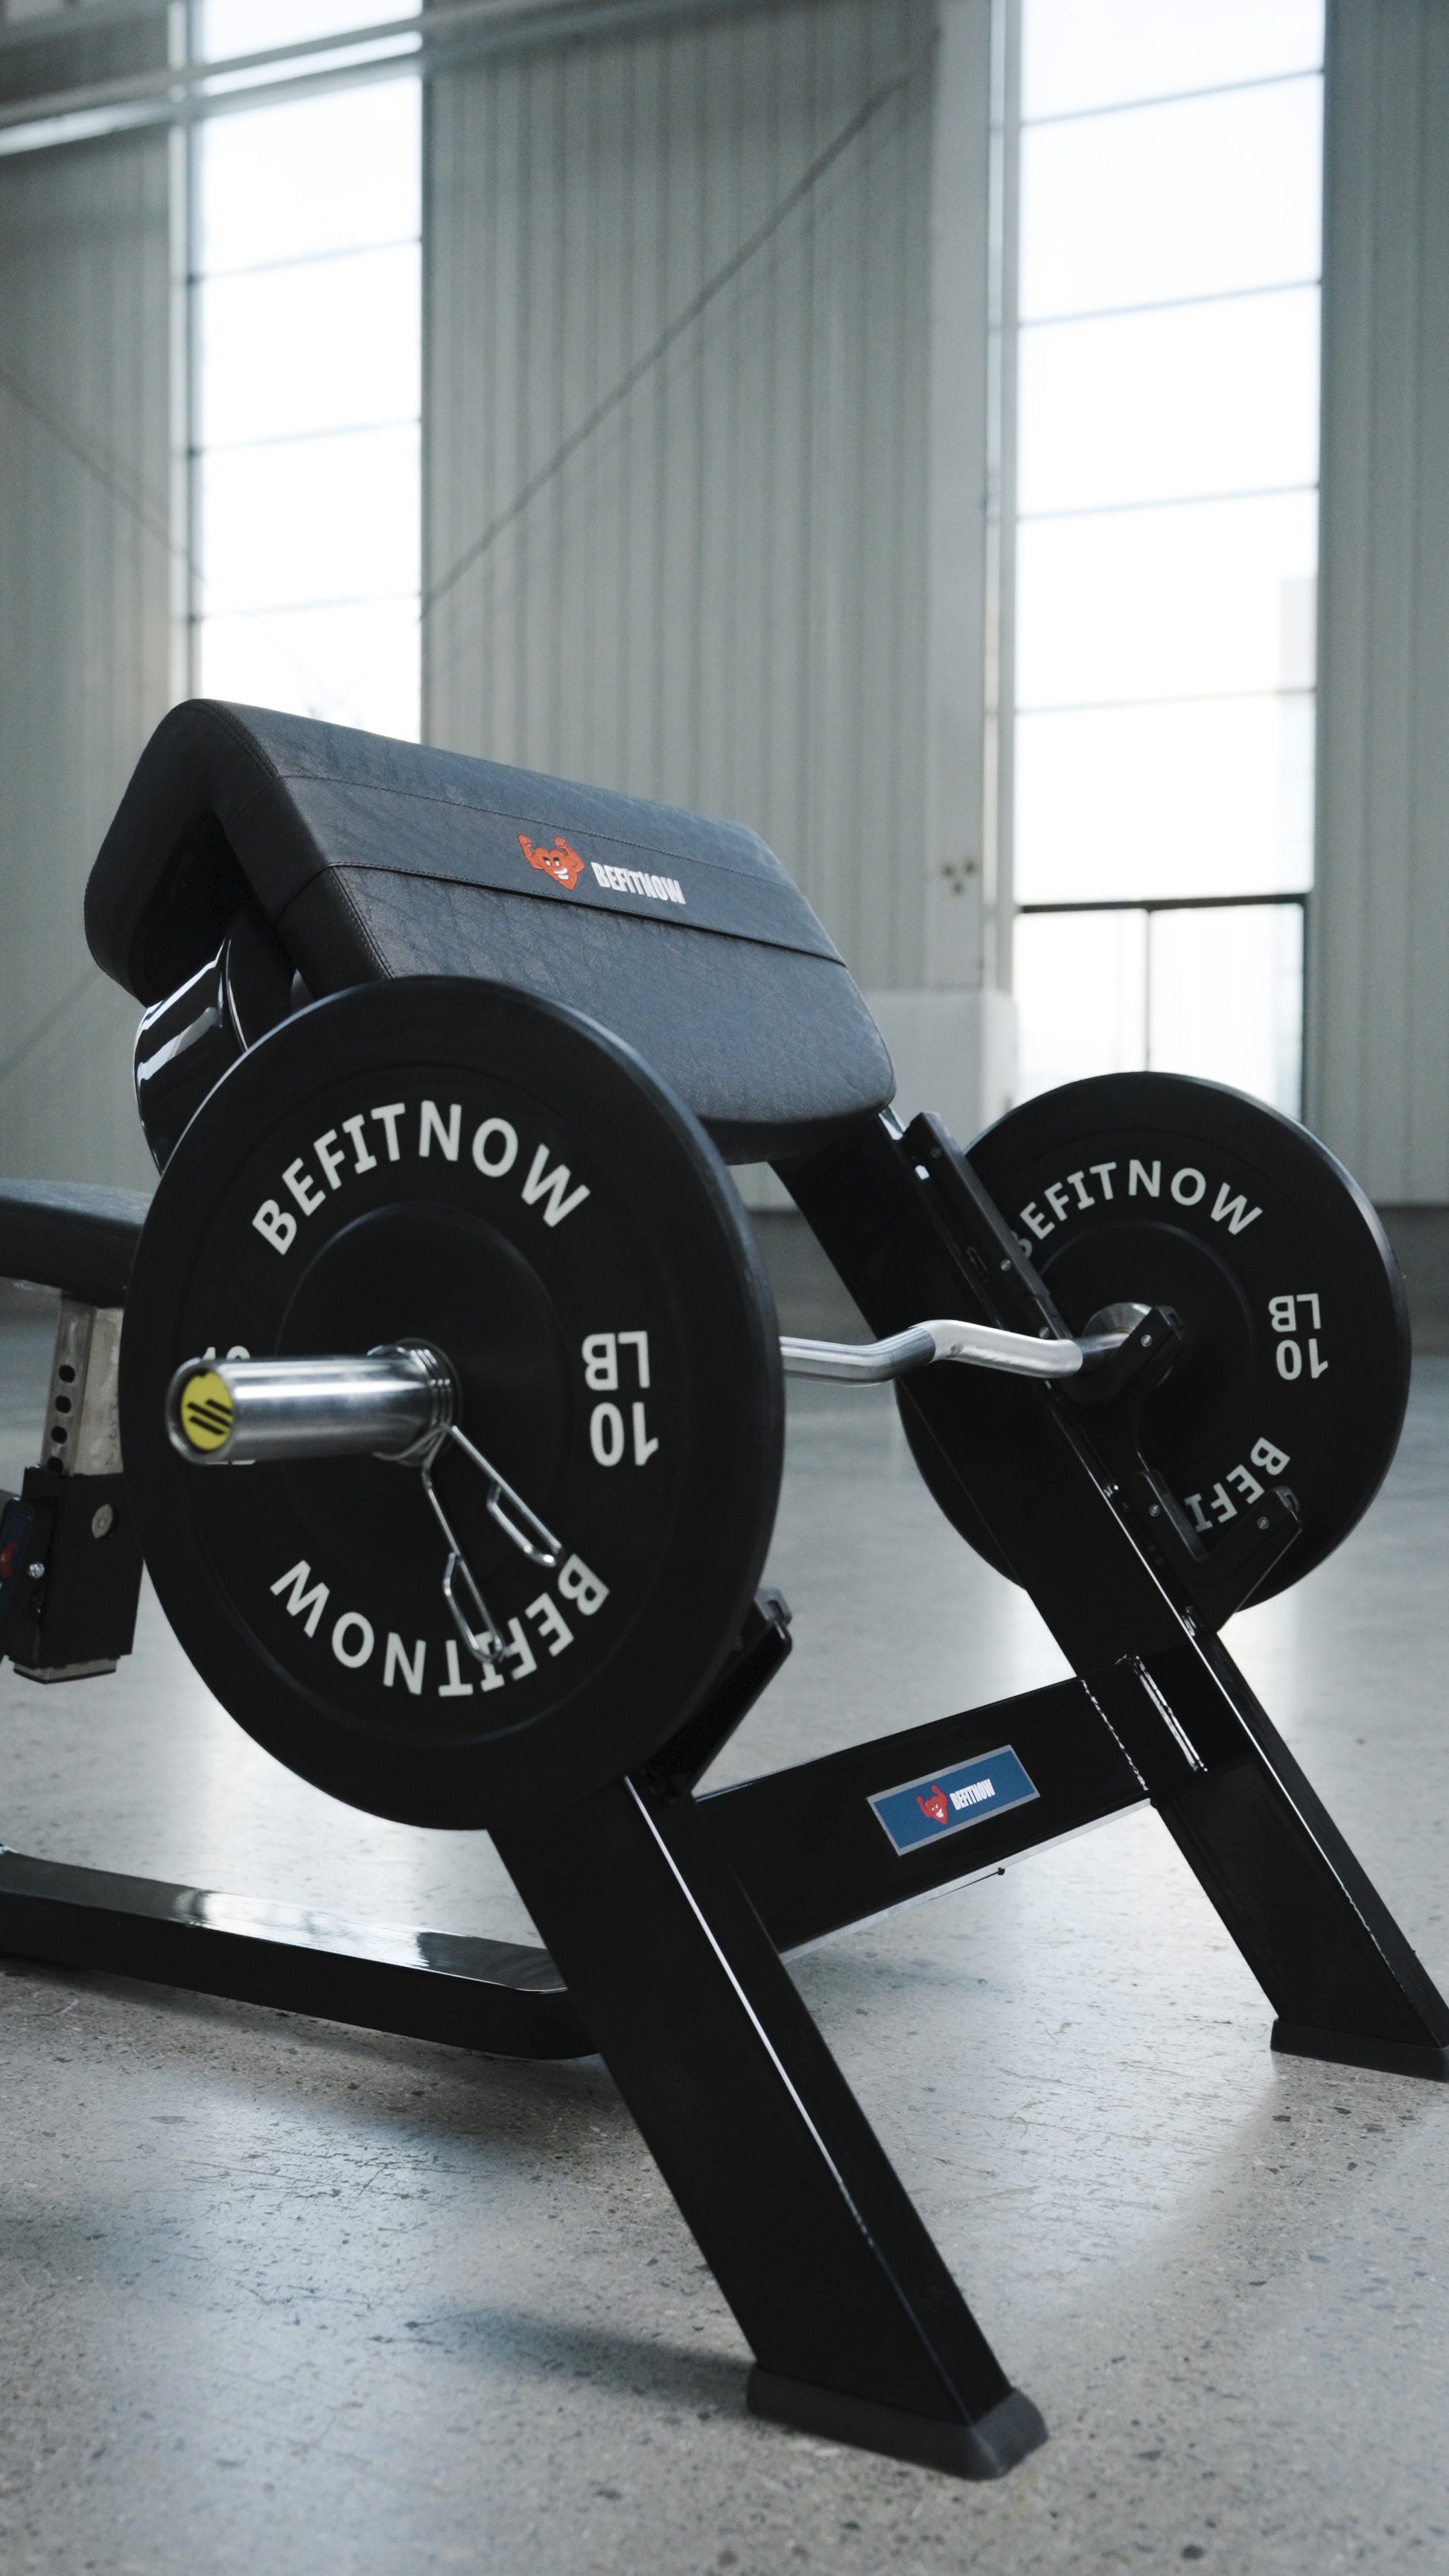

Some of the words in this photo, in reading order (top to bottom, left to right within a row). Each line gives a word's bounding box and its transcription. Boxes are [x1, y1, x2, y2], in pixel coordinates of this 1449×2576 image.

[590, 861, 687, 905] BEFITNOW
[251, 1099, 591, 1256] BEFITNOW
[1268, 1292, 1322, 1333] LB
[581, 1330, 651, 1392] LB
[1276, 1338, 1329, 1381] 10
[590, 1401, 660, 1467] 10
[1184, 1437, 1291, 1532] BEFI
[269, 1553, 610, 1697] BEFITNOW
[949, 1778, 996, 1811] BEFITNOW
